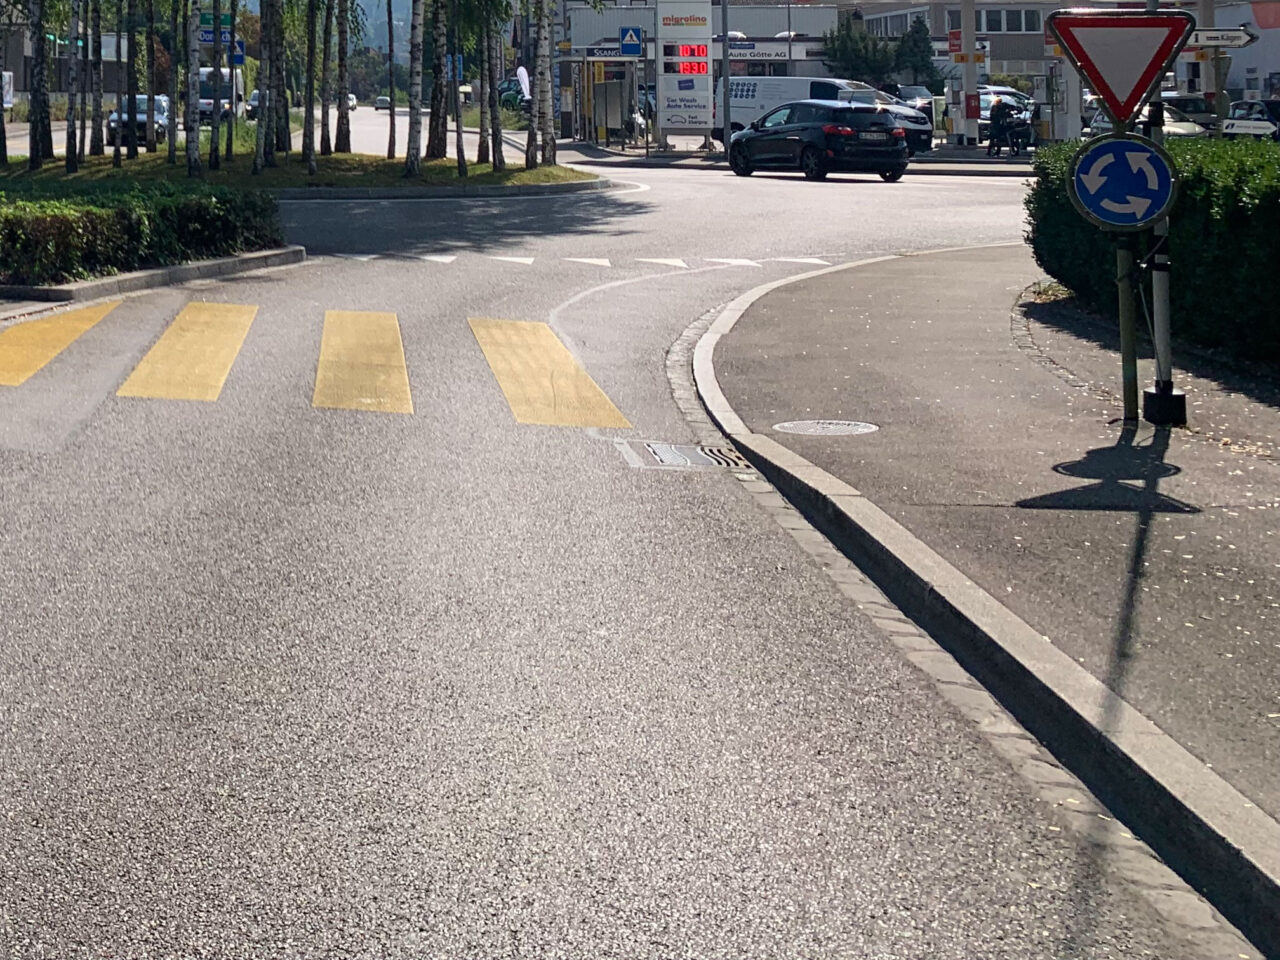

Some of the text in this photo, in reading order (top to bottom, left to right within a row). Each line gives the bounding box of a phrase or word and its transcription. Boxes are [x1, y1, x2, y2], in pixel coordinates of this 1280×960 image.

[662, 15, 707, 24] migrolino
[593, 48, 620, 57] SSANG
[749, 50, 772, 58] Götte
